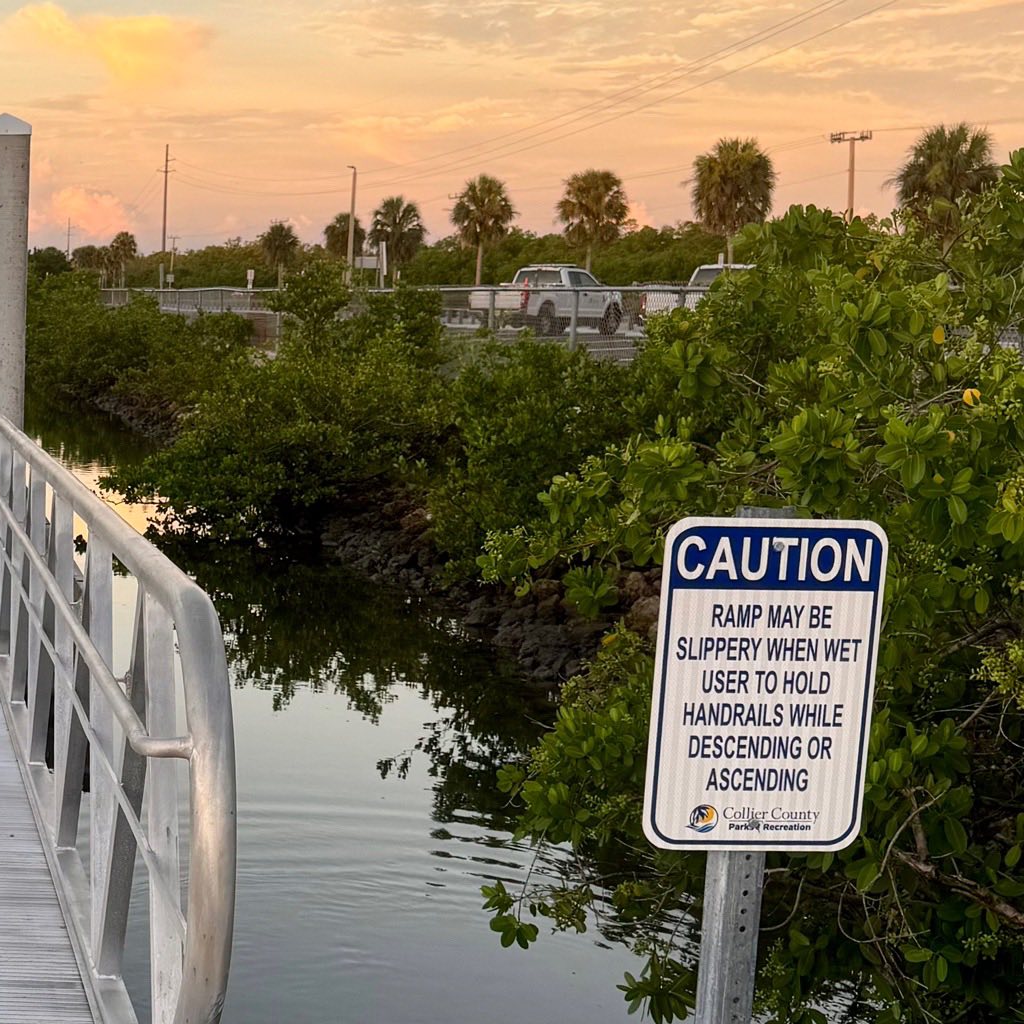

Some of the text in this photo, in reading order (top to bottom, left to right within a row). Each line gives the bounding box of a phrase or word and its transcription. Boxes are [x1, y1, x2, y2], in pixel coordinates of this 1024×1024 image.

[676, 535, 874, 582] CAUTION
[711, 604, 833, 629] RAMP MAY BE
[676, 636, 862, 662] SLIPPERY WHEN WET
[702, 670, 831, 695] USER TO HOLD
[683, 702, 844, 727] HANDRAILS WHILE
[688, 735, 832, 759] DESCENDING OR
[706, 768, 809, 792] ASCENDING
[722, 806, 820, 824] Collier County
[763, 823, 811, 831] Recreation
